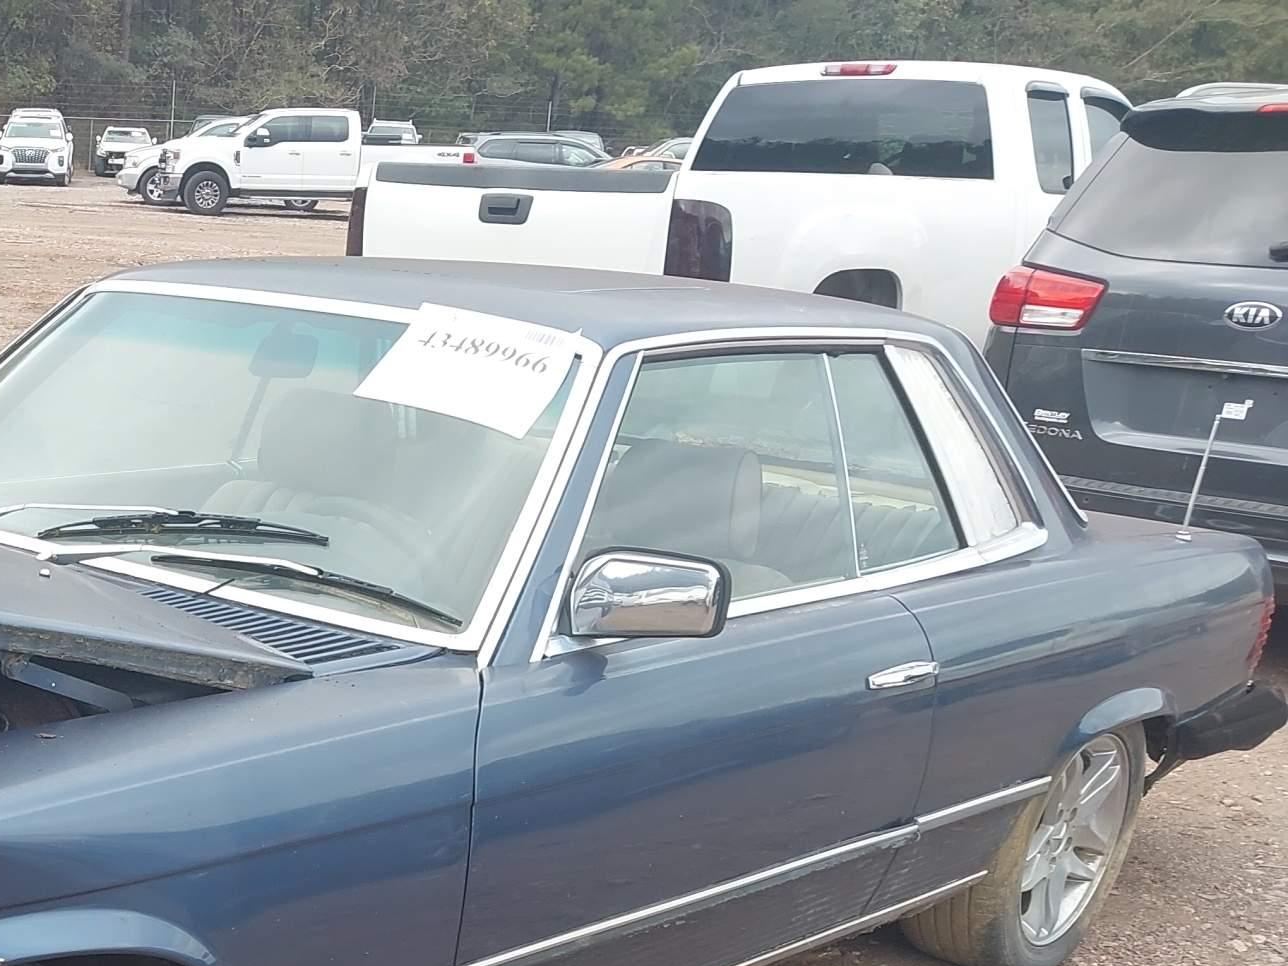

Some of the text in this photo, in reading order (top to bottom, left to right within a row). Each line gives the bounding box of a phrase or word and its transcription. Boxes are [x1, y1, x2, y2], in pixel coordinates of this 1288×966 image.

[1232, 307, 1270, 324] KIA
[418, 331, 551, 374] 43489966
[1023, 421, 1083, 440] EDONA
